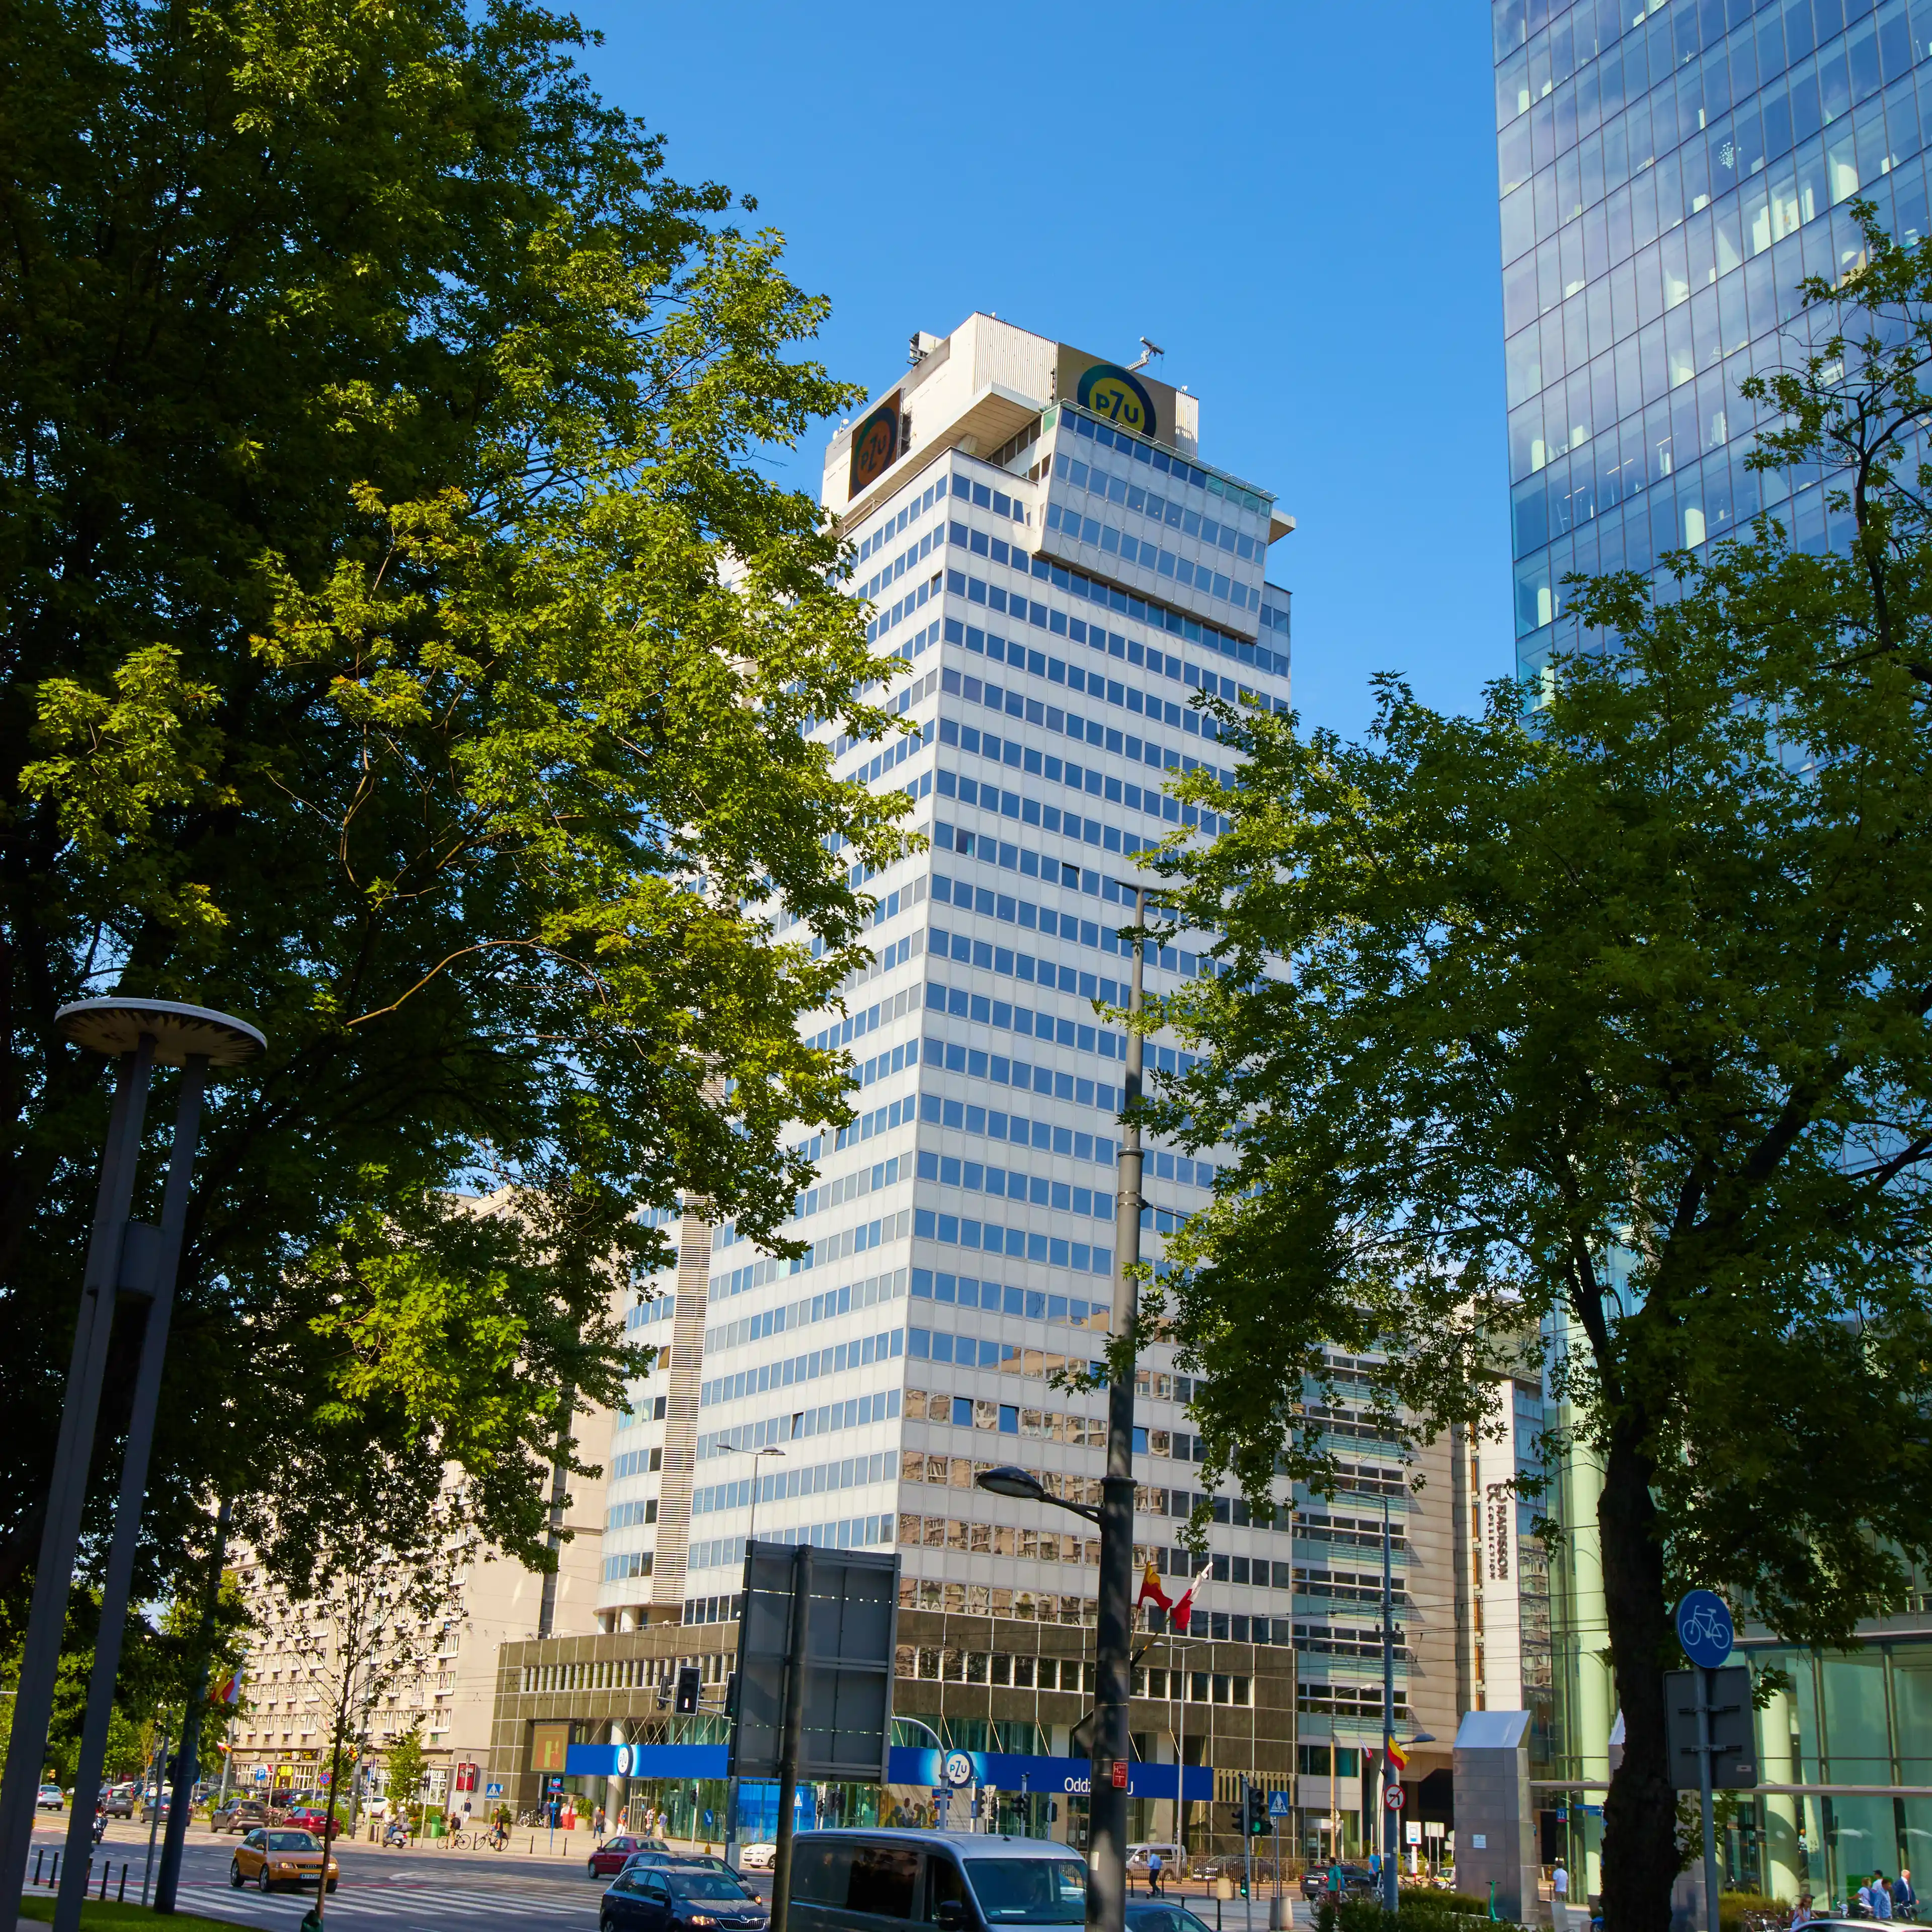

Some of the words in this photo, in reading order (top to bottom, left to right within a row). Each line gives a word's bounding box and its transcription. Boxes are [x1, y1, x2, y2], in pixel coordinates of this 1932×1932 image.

[861, 434, 887, 472] PZU
[1496, 1504, 1508, 1580] RADISSON
[950, 1760, 967, 1778] PZU
